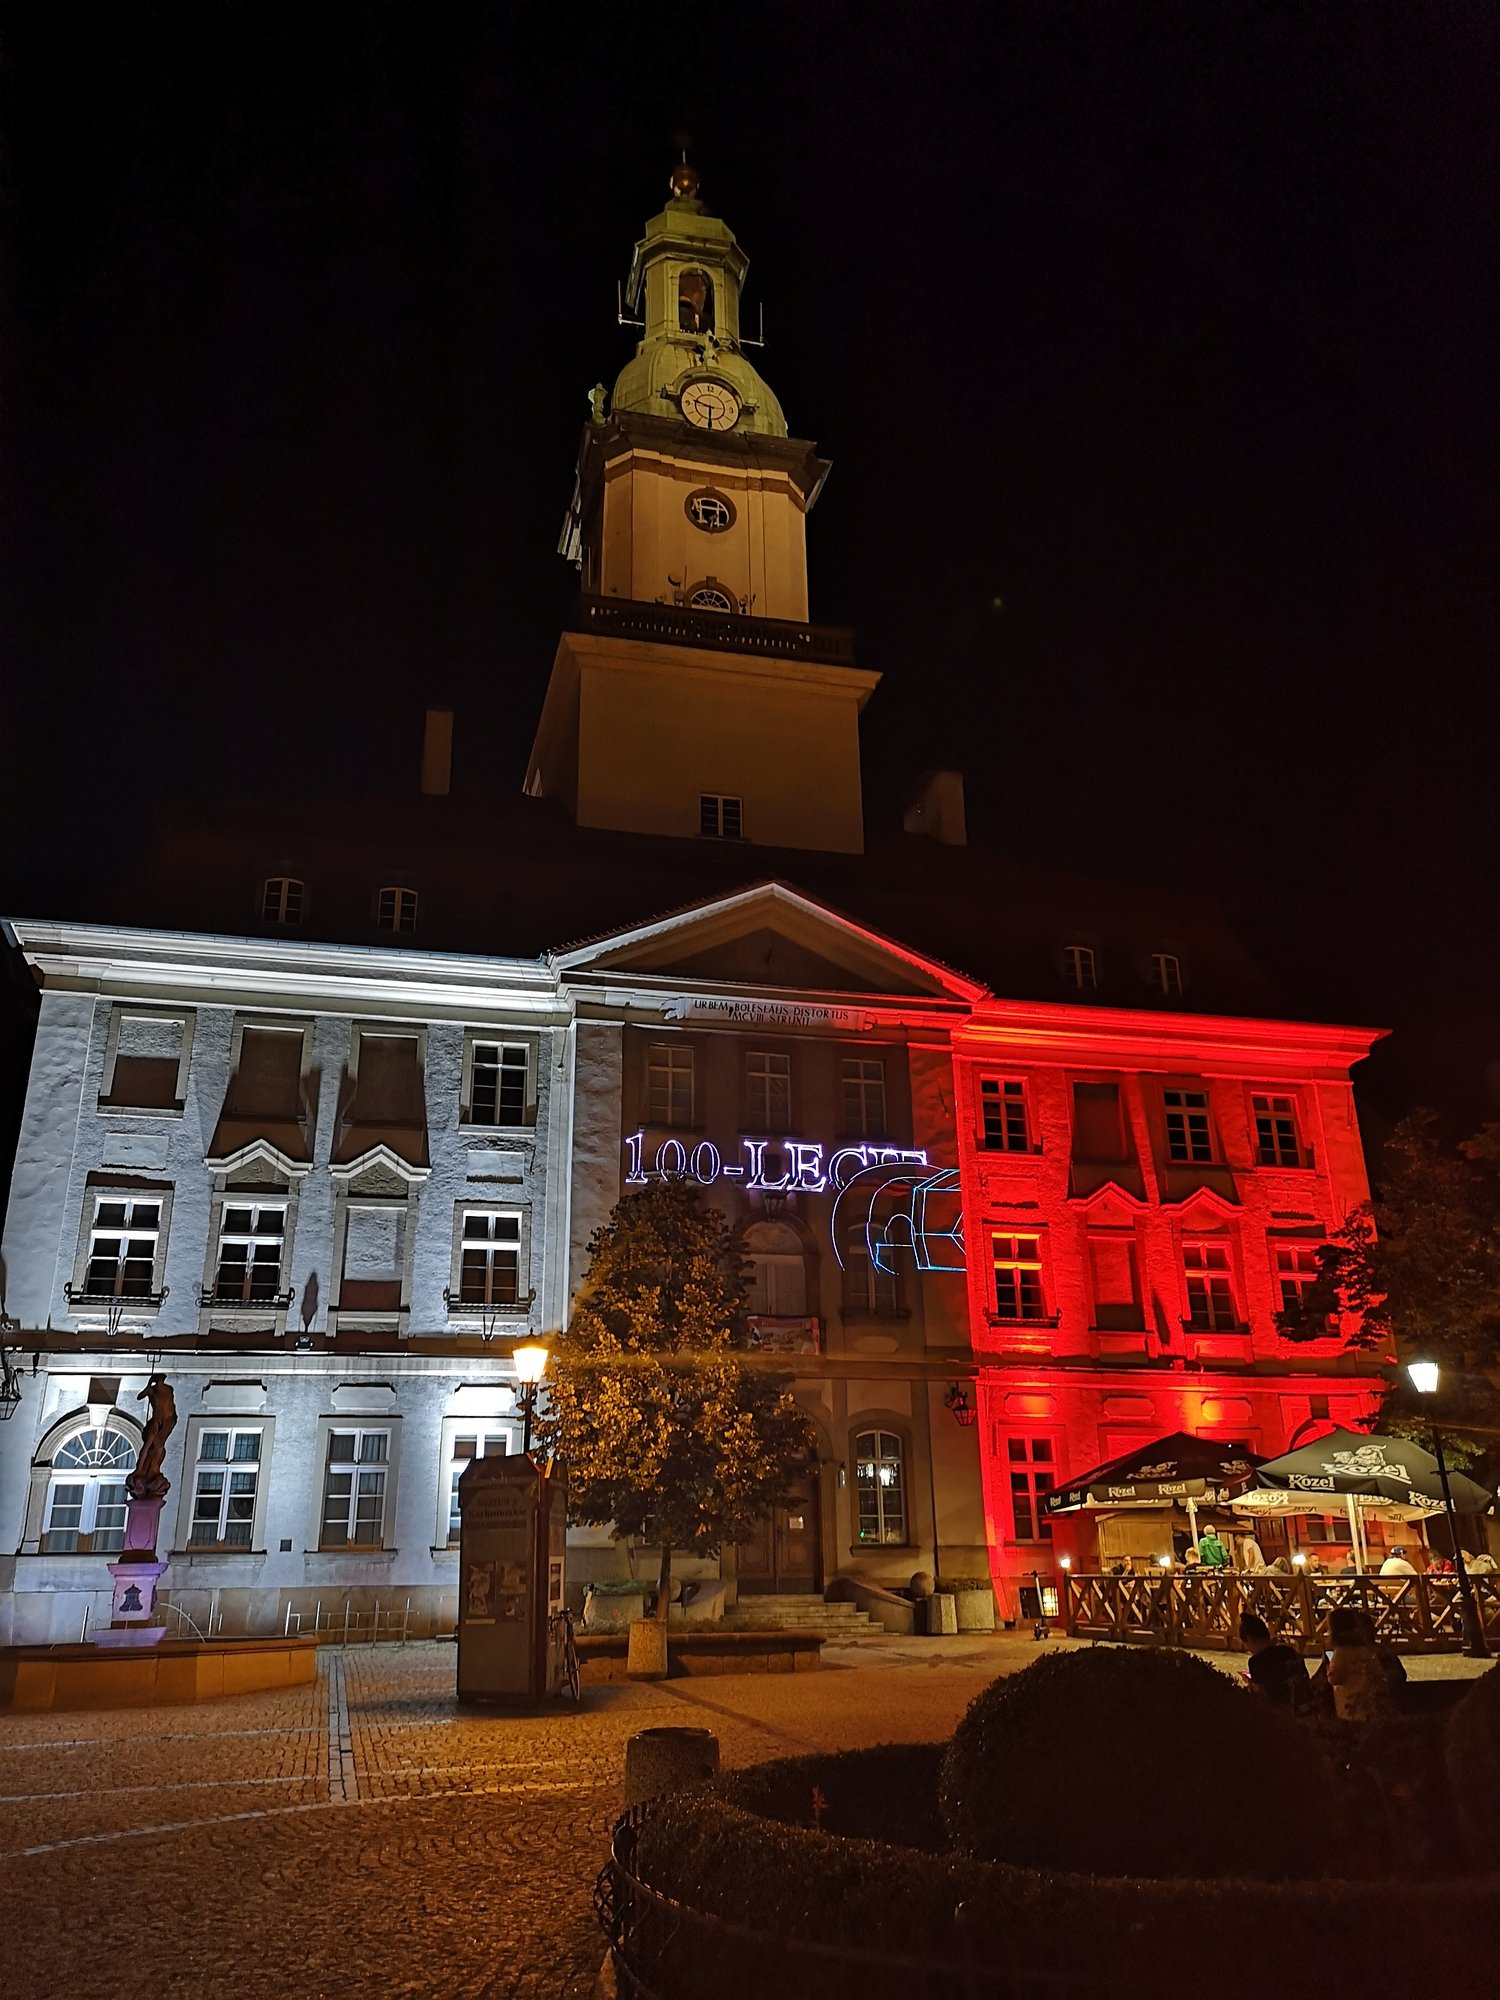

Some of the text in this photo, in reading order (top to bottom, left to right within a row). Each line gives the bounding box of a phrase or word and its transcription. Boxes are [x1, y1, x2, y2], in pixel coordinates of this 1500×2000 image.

[706, 385, 715, 393] 12
[685, 399, 691, 407] 9
[1321, 1462, 1413, 1485] Kozel
[1108, 1485, 1137, 1498] Kozel
[1158, 1482, 1187, 1495] Kozel
[1288, 1473, 1336, 1491] Kozel
